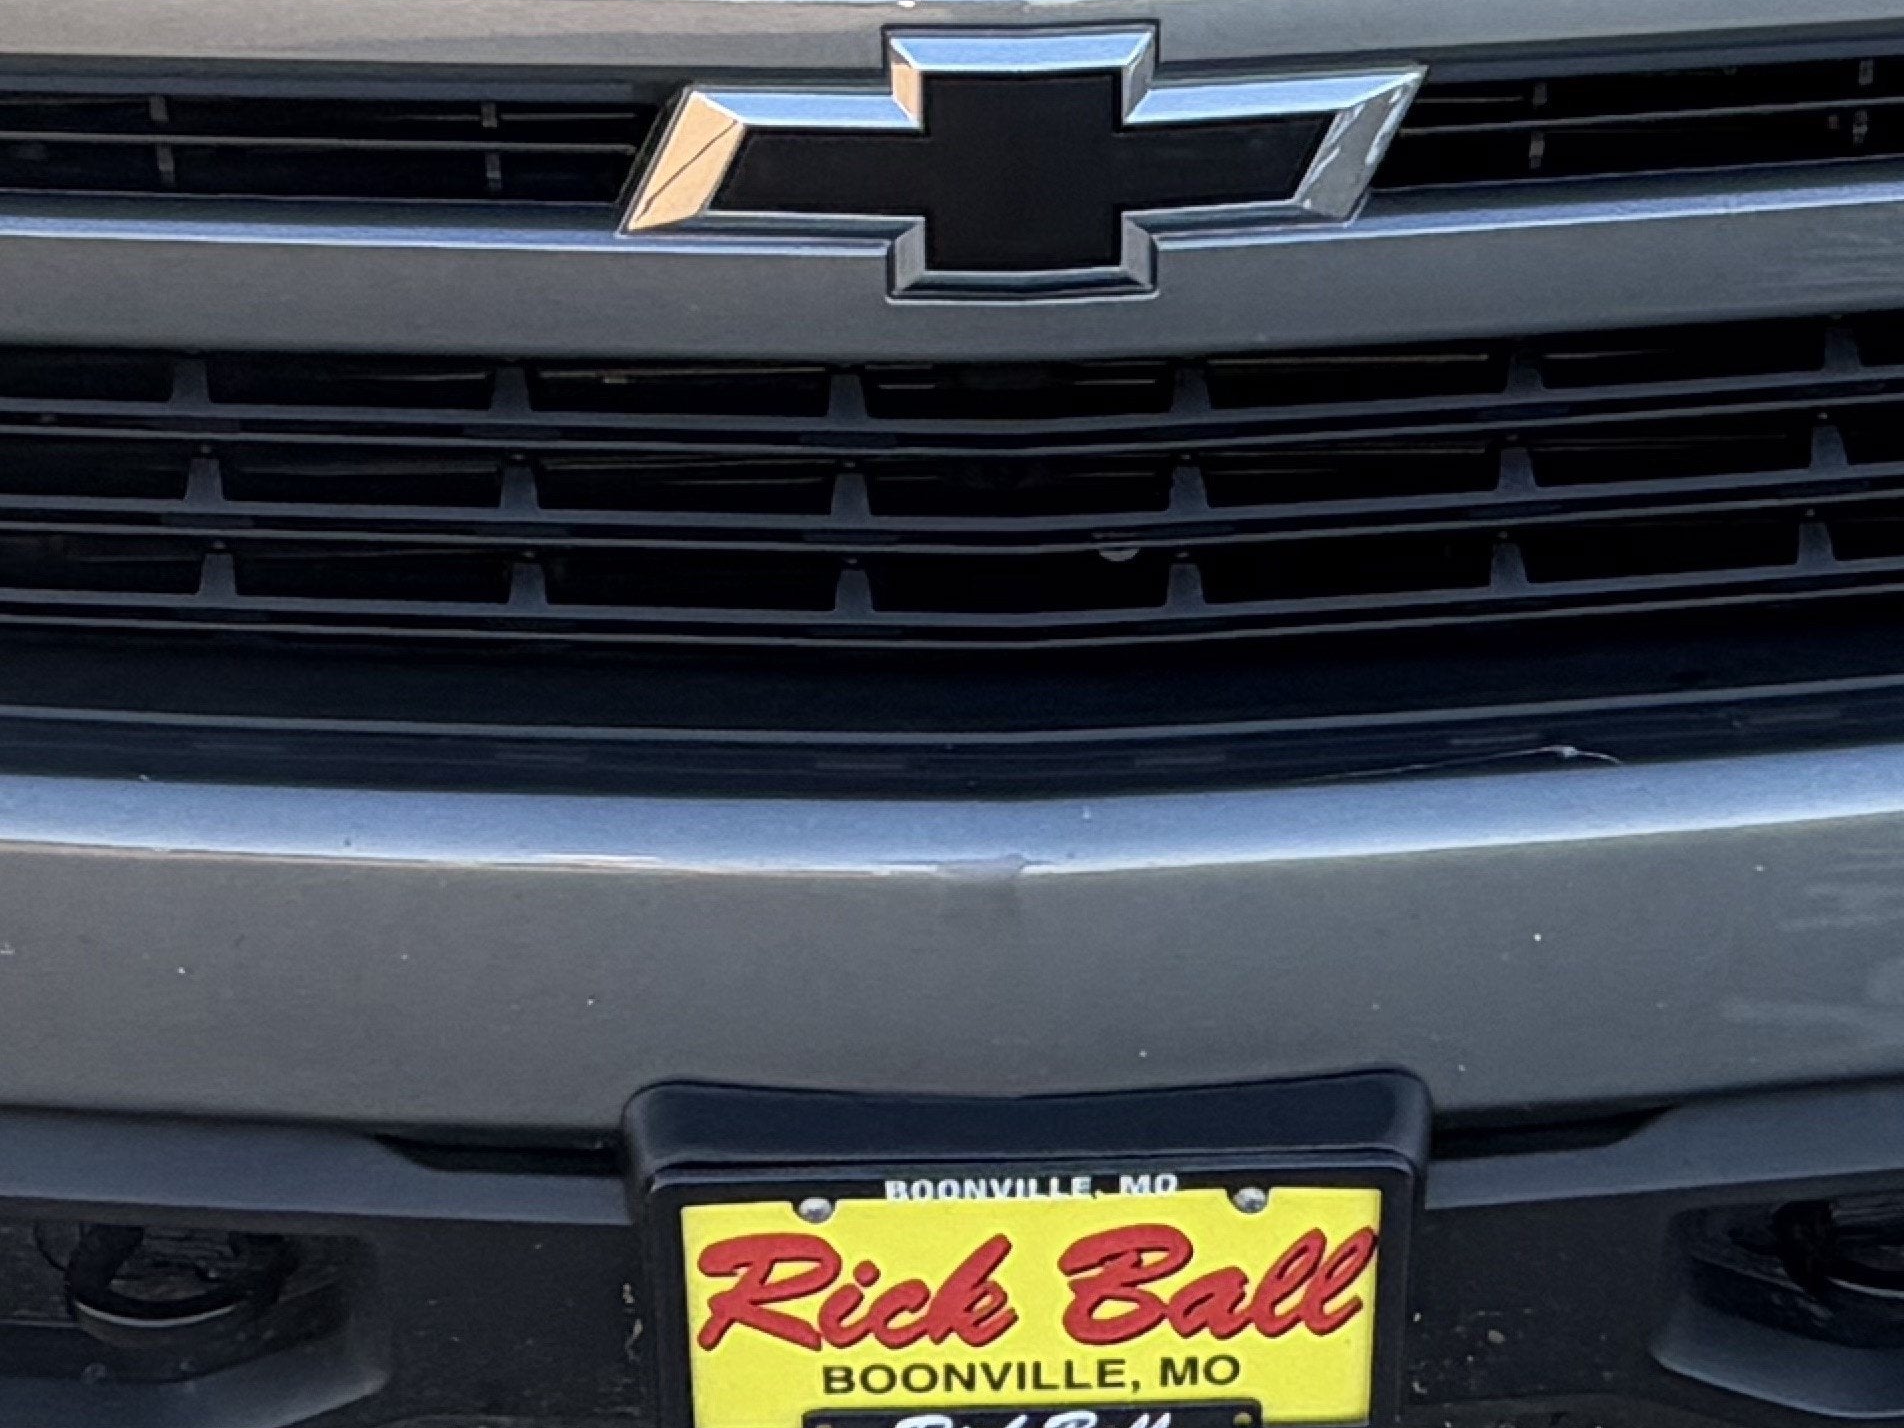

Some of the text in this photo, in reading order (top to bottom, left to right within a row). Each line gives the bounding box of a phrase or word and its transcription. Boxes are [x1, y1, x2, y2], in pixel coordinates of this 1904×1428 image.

[1119, 1174, 1178, 1195] MO
[696, 1223, 1378, 1352] Rick Ball
[821, 1354, 1241, 1394] BOONVILLE, MO
